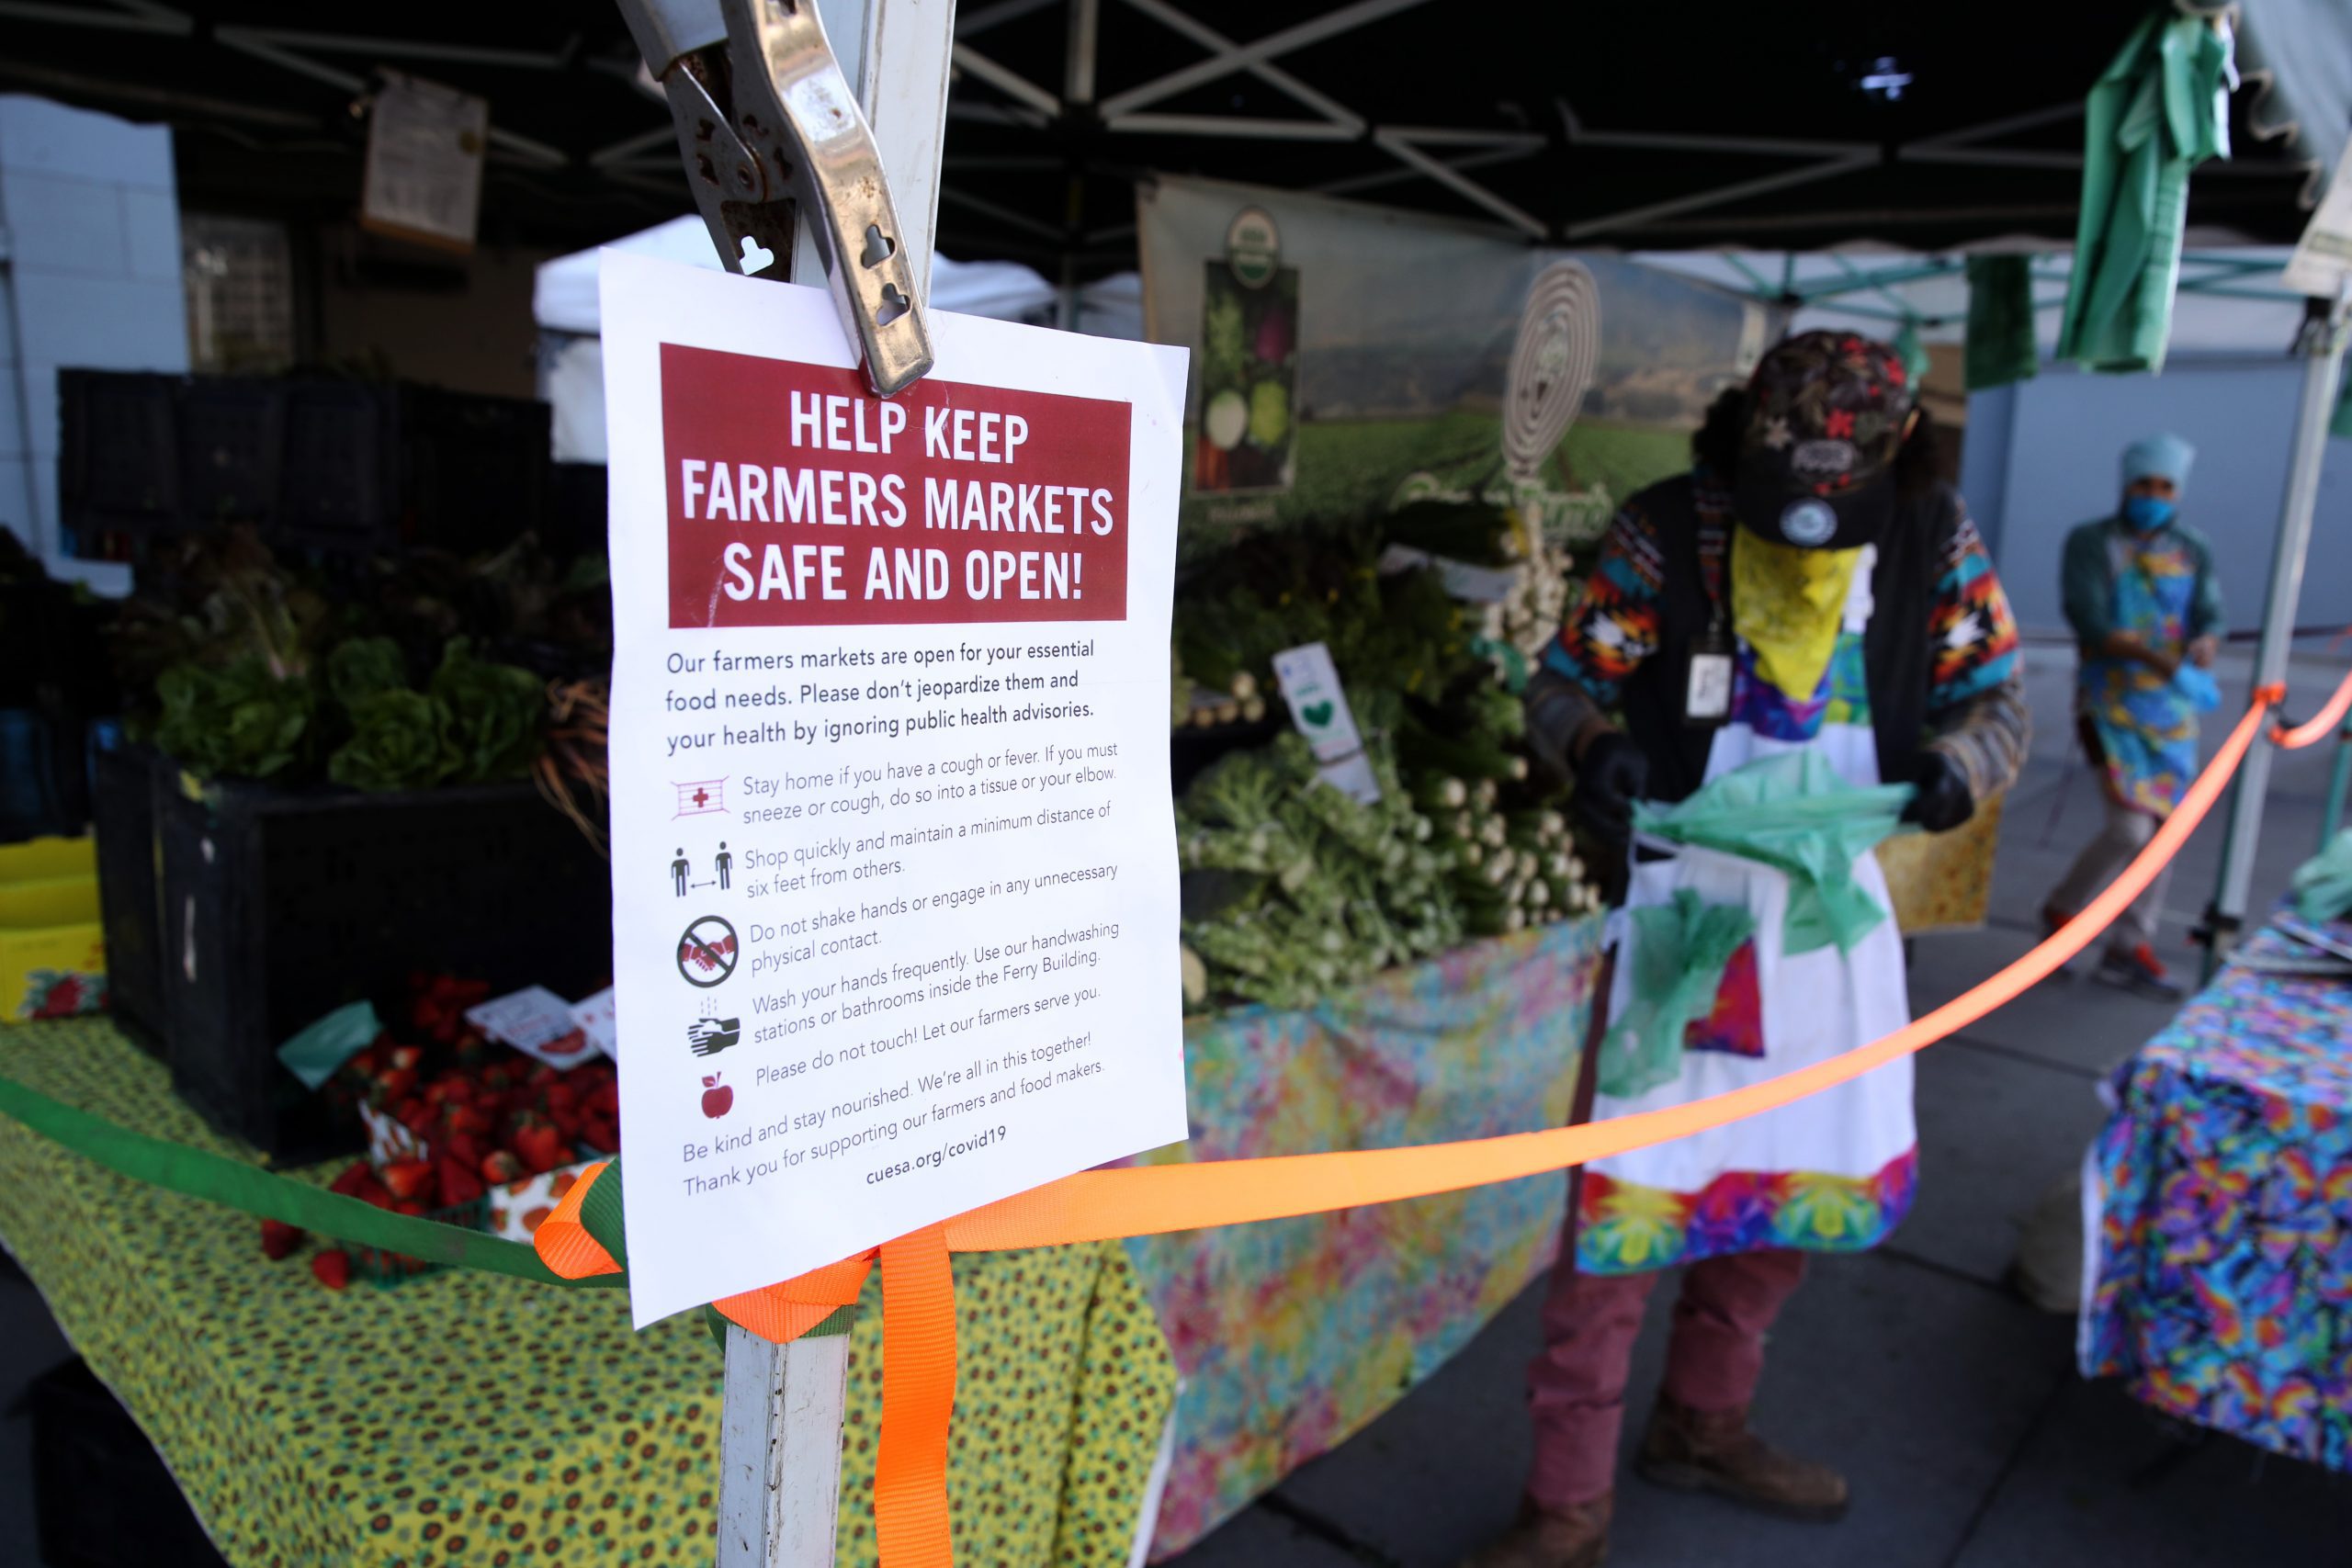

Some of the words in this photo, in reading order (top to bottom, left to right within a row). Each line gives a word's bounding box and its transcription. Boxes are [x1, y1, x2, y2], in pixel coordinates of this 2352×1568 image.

[791, 390, 906, 454] HELP
[925, 406, 1028, 463] KEEP
[683, 459, 907, 527] FARMERS
[925, 478, 1113, 536] MARKETS
[724, 543, 846, 601] SAFE
[865, 547, 949, 600] AND
[966, 549, 1081, 600] OPEN!
[667, 652, 706, 673] Our
[713, 649, 794, 671] farmers
[801, 647, 875, 668] markets
[881, 651, 908, 665] are
[914, 649, 955, 668] open
[960, 642, 982, 661] for
[987, 647, 1022, 665] your
[1027, 639, 1093, 659] essential
[665, 688, 717, 712] food
[725, 684, 792, 708] needs.
[800, 682, 859, 704] Please
[866, 680, 911, 700] don't
[916, 674, 1000, 703] jeopardize
[1005, 672, 1044, 691] them
[1050, 670, 1078, 688] and
[667, 733, 716, 757] your
[724, 721, 786, 745] health
[795, 720, 818, 745] by
[825, 715, 899, 743] ignoring
[906, 709, 956, 736] public
[961, 705, 1007, 726] health
[1013, 701, 1093, 722] advisories.
[743, 776, 779, 797] Stay
[786, 772, 833, 790] home
[840, 765, 850, 784] if
[854, 769, 881, 789] you
[888, 761, 922, 779] have
[928, 763, 935, 775] a
[941, 753, 982, 775] cough
[988, 756, 1001, 768] or
[1004, 749, 1039, 766] fever.
[1046, 744, 1054, 761] If
[1058, 749, 1082, 765] you
[1088, 743, 1117, 758] must
[743, 806, 802, 824] sneeze
[808, 802, 826, 816] or
[831, 790, 884, 815] cough,
[890, 787, 910, 806] do
[915, 790, 932, 803] so
[938, 784, 964, 800] into
[969, 784, 976, 795] a
[980, 779, 1017, 795] tissue
[1022, 777, 1035, 788] or
[1039, 773, 1071, 792] your
[1076, 766, 1115, 783] elbow.
[745, 849, 788, 871] Shop
[794, 837, 851, 867] quickly
[856, 830, 885, 852] and
[891, 824, 953, 847] maintain
[958, 826, 966, 837] a
[971, 816, 1032, 835] minimum
[1037, 808, 1094, 825] distance
[1099, 800, 1111, 818] of
[747, 879, 769, 898] six
[774, 874, 806, 893] feet
[810, 867, 847, 886] from
[853, 860, 905, 879] others.
[751, 924, 775, 942] Do
[781, 919, 808, 937] not
[812, 907, 855, 930] shake
[861, 897, 907, 920] hands
[912, 897, 928, 910] or
[933, 887, 985, 908] engage
[990, 881, 1001, 896] in
[1007, 879, 1030, 895] any
[1035, 865, 1117, 887] unnecessary
[752, 940, 815, 977] physical
[821, 931, 881, 955] contact.
[752, 989, 796, 1014] Wash
[802, 983, 836, 1009] your
[842, 967, 888, 992] hands
[892, 951, 968, 982] frequently.
[975, 946, 1000, 963] Use
[1005, 942, 1027, 956] our
[1032, 923, 1118, 951] handwashing
[754, 1016, 815, 1043] stations
[821, 1010, 837, 1024] or
[842, 990, 924, 1020] bathrooms
[930, 975, 971, 998] inside
[976, 970, 998, 987] the
[1003, 964, 1037, 981] Ferry
[1043, 950, 1100, 972] Building.
[757, 1061, 807, 1086] Please
[812, 1050, 833, 1069] do
[840, 1043, 865, 1062] not
[870, 1027, 917, 1054] touch!
[923, 1022, 945, 1041] Let
[950, 1017, 974, 1032] our
[978, 1004, 1030, 1026] farmers
[1035, 994, 1069, 1011] serve
[1074, 987, 1100, 1007] you.
[684, 1144, 708, 1162] Be
[716, 1126, 752, 1154] kind
[759, 1115, 787, 1141] and
[794, 1110, 826, 1130] stay
[832, 1080, 913, 1119] nourished.
[918, 1070, 961, 1092] We're
[967, 1060, 981, 1079] all
[987, 1059, 998, 1074] in
[1002, 1051, 1027, 1069] this
[1031, 1032, 1091, 1062] together!
[684, 1166, 741, 1196] Thank
[746, 1160, 777, 1185] you
[783, 1148, 806, 1168] for
[811, 1122, 897, 1159] supporting
[903, 1113, 927, 1130] our
[932, 1096, 985, 1122] farmers
[990, 1081, 1015, 1104] and
[1020, 1070, 1051, 1094] food
[1057, 1062, 1104, 1084] makers.
[866, 1125, 1006, 1184] cuesa.org/covid19
